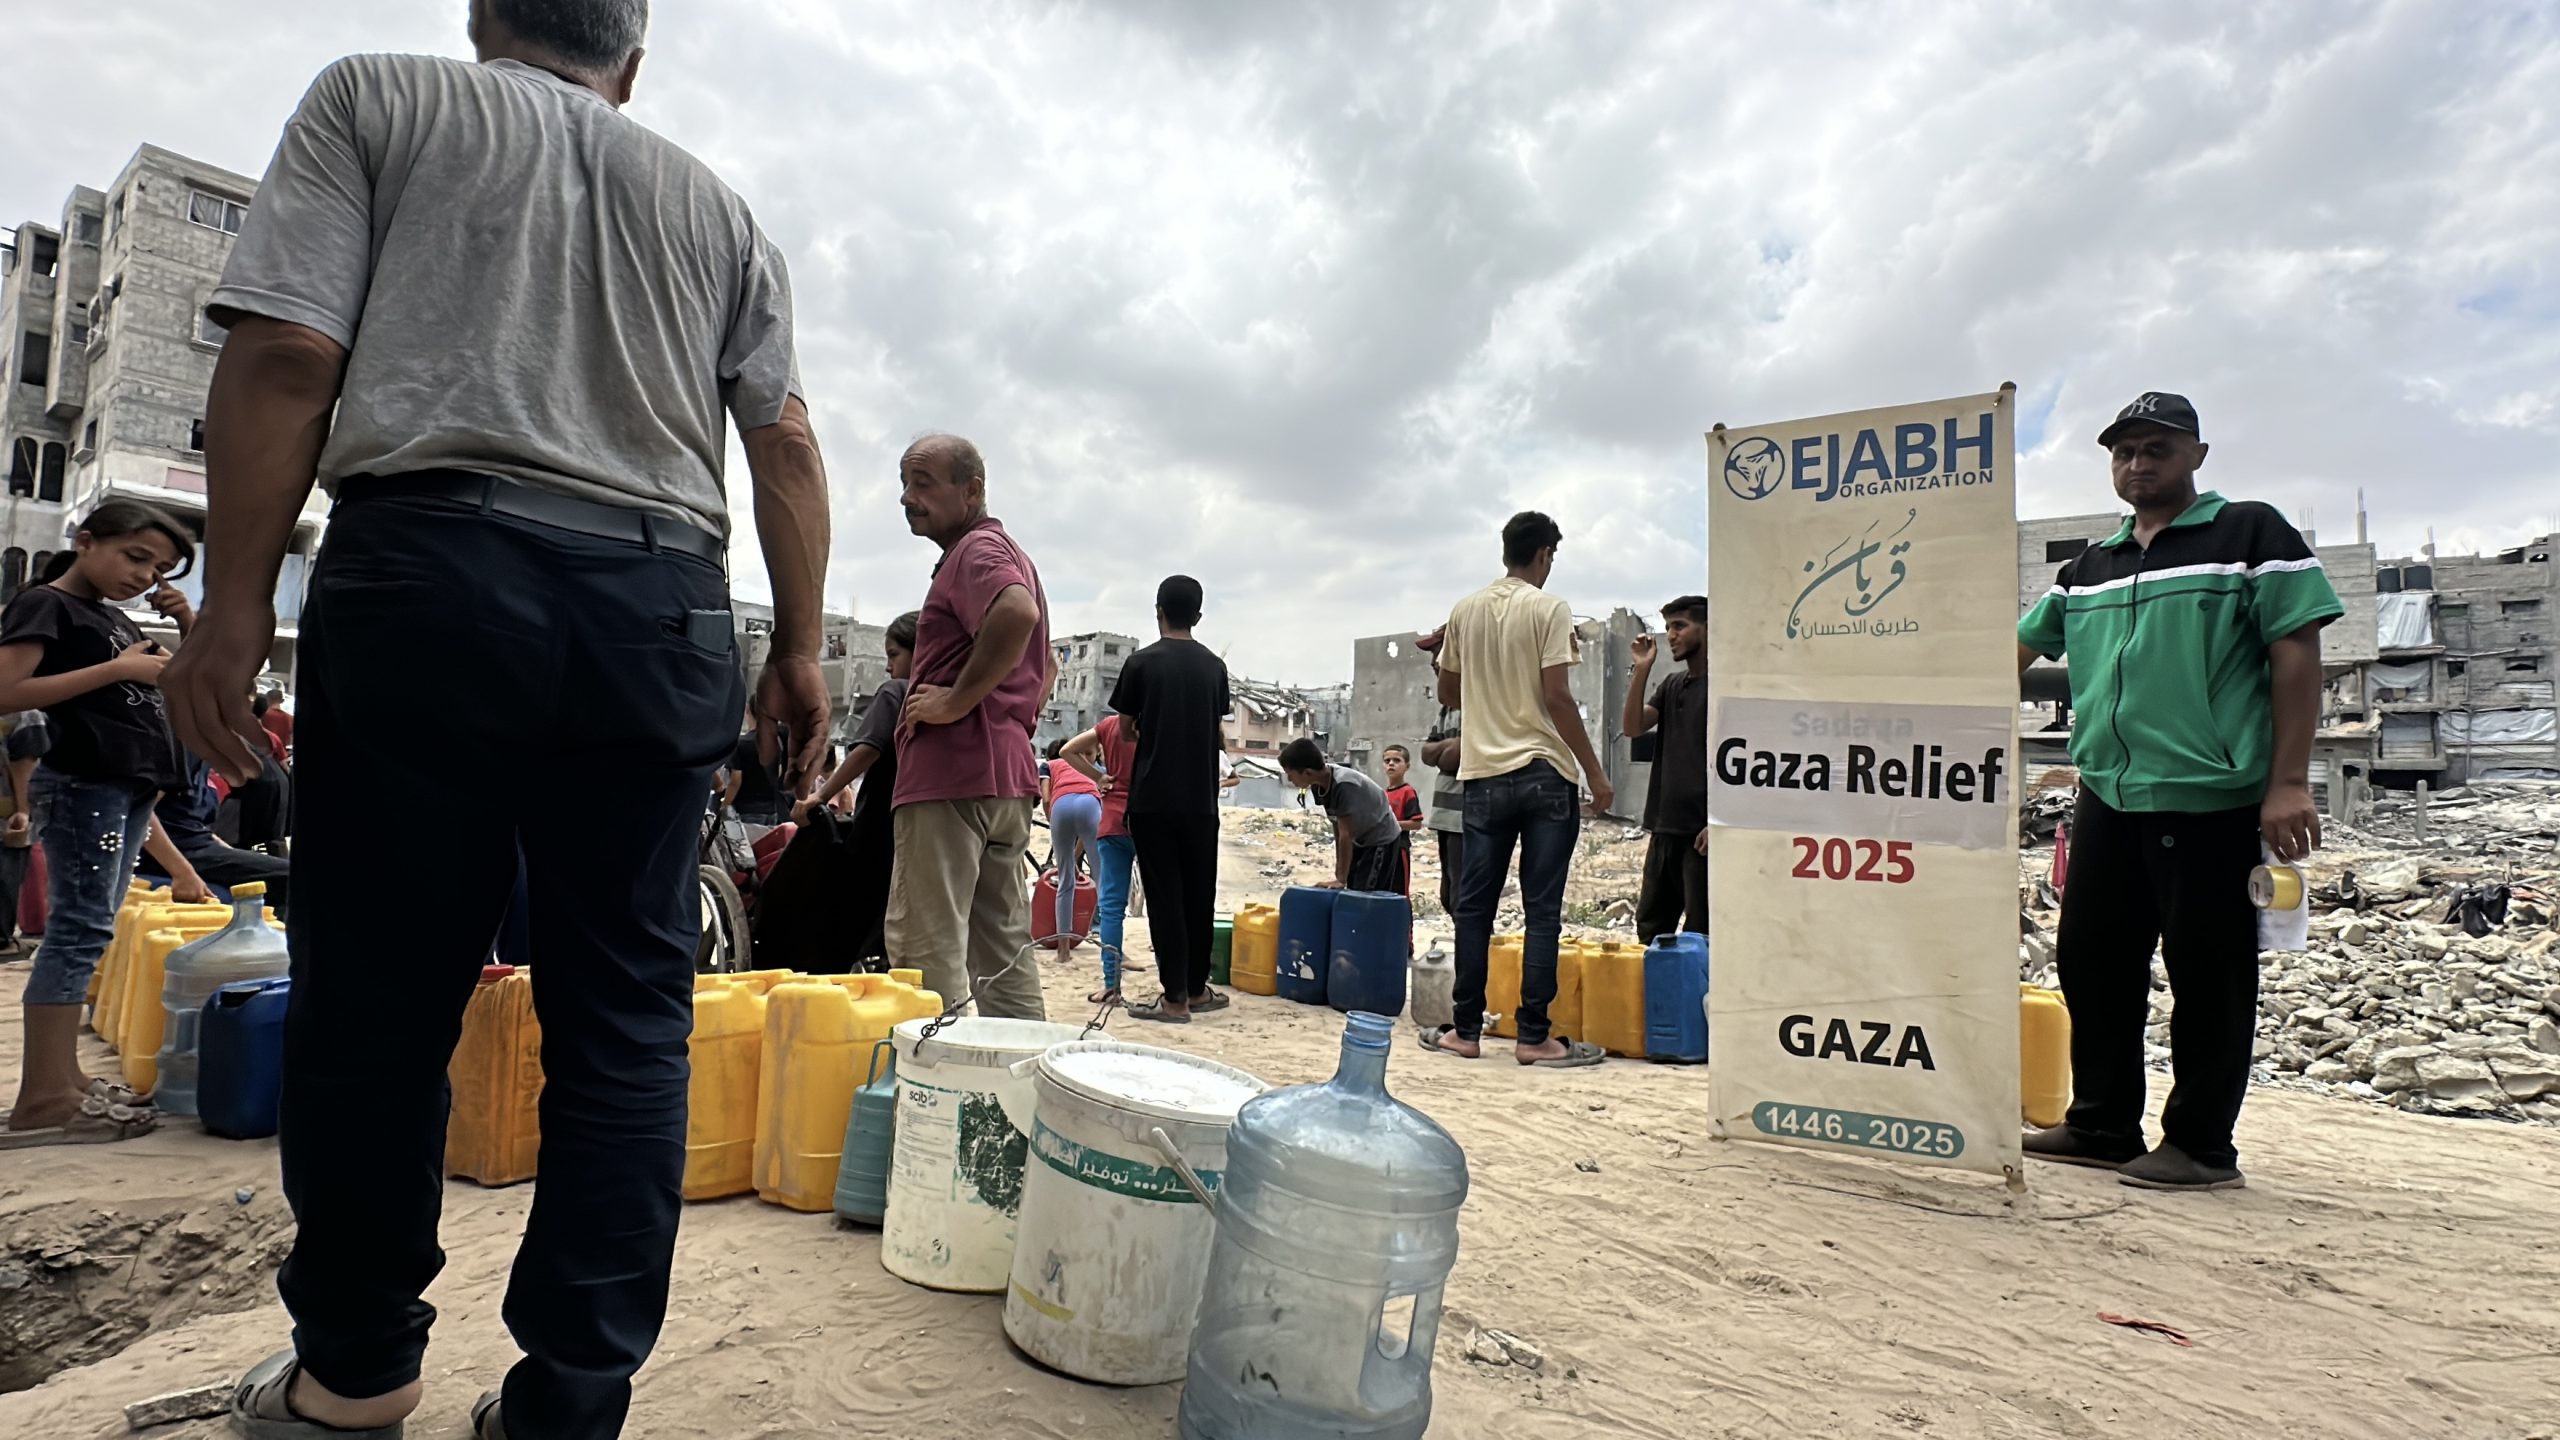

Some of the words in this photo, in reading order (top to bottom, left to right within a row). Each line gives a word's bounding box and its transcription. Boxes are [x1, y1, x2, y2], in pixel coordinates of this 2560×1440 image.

[1791, 413, 1994, 502] EJABH
[1840, 469, 1993, 498] ORGANIZATION
[1870, 617, 1919, 637] طريق
[1715, 737, 1831, 791] Gaza
[1847, 744, 2004, 803] Relief
[1792, 837, 1915, 884] 2025
[1778, 1014, 1936, 1071] GAZA
